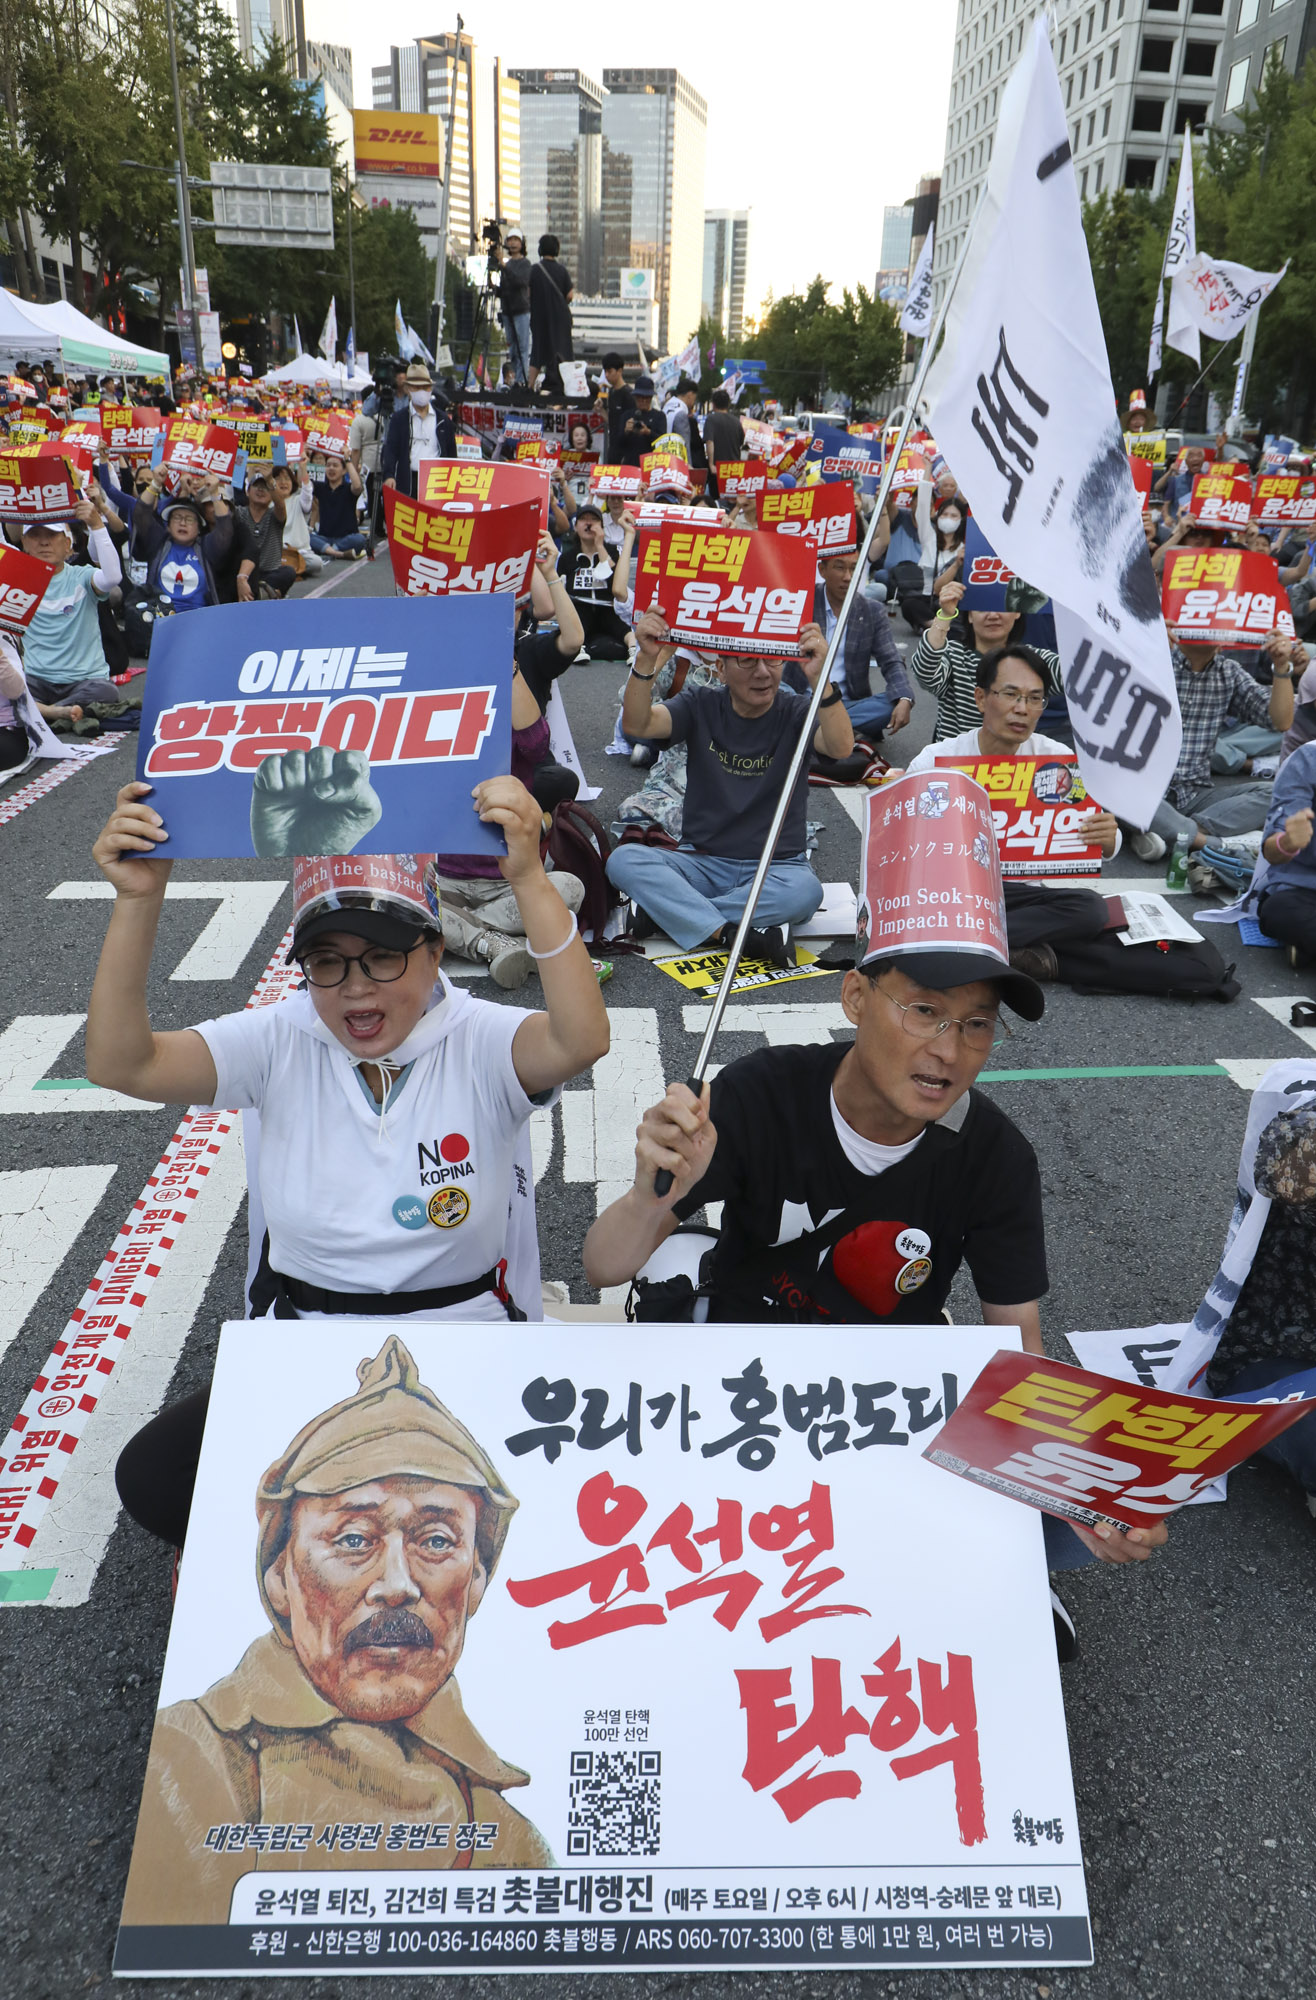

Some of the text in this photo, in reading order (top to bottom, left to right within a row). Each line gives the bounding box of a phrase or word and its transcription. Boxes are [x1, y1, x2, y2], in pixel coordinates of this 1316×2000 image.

[368, 128, 427, 145] DHL
[102, 410, 132, 428] 탄핵
[169, 421, 208, 445] 탄핵
[111, 427, 160, 446] 윤석열
[240, 432, 257, 444] 석열
[307, 432, 345, 452] 윤석열
[517, 442, 540, 459] 탄핵
[170, 442, 233, 472] 윤석열
[643, 454, 671, 472] 탄핵
[839, 447, 871, 460] 이제는
[0, 460, 21, 485] 핵
[425, 466, 494, 501] 탄핵
[593, 466, 621, 477] 탄핵
[597, 476, 640, 490] 윤석열
[650, 468, 689, 486] 윤석열
[719, 463, 745, 479] 탄핵
[725, 476, 766, 494] 윤석열
[0, 482, 70, 511] 윤석열
[1195, 478, 1235, 498] 탄핵
[1258, 478, 1299, 498] 탄핵
[763, 490, 815, 522] 탄핵
[1200, 498, 1250, 522] 윤석열
[1261, 498, 1316, 518] 윤석열
[393, 501, 475, 563] 탄핵
[408, 549, 532, 595] 윤석열
[666, 533, 751, 582] 탄핵
[1168, 553, 1242, 590] 탄핵
[675, 582, 808, 635] 윤석열
[1177, 590, 1276, 629] 윤석열
[238, 646, 408, 694] 이제는
[145, 686, 497, 778] 항쟁이다
[709, 740, 728, 764] Lst
[949, 762, 1036, 808] 탄핵
[882, 797, 916, 826] 윤석열
[952, 796, 977, 819] 새끼
[334, 862, 363, 876] the
[877, 891, 911, 916] Yoon
[878, 911, 949, 938] Impeach
[955, 911, 985, 931] the
[161, 1138, 209, 1186] 안전제일
[418, 1133, 470, 1170] NO
[420, 1161, 475, 1186] KOPINA
[134, 1209, 173, 1235] 위험
[96, 1241, 154, 1306] DANGER!
[51, 1314, 118, 1392] 안전제일
[504, 1376, 702, 1464] 우리가
[984, 1372, 1264, 1469] 탄핵
[8, 1429, 61, 1473] 위험
[993, 1441, 1204, 1514] 윤석
[505, 1471, 872, 1651] 윤석열
[583, 1708, 650, 1725] 윤석열 탄핵
[583, 1726, 649, 1744] 100만 선언
[733, 1634, 988, 1848] 탄핵
[203, 1822, 498, 1853] 대한독립군 사령관 홍범도 장군
[1011, 1809, 1064, 1846] 촛불행동
[255, 1875, 1062, 1918] 윤석열 퇴진, 김건희 특검 촛불대행진 (매주 토요일 / 오후 6시 / 시청역-숭례문 앞 대로)
[249, 1930, 288, 1956] 후원
[305, 1929, 381, 1955] 신한은행
[387, 1930, 538, 1953] 100-036-164860
[542, 1928, 617, 1954] 촛불행동
[622, 1927, 632, 1954] /
[635, 1928, 673, 1951] ARS
[678, 1927, 804, 1951] 060-707-3300
[809, 1925, 834, 1951] (한
[839, 1925, 875, 1949] 통에
[882, 1924, 910, 1949] 1만
[916, 1924, 941, 1950] 원,
[945, 1924, 982, 1949] 여러
[987, 1923, 1005, 1948] 번
[1010, 1922, 1054, 1950] 가능)
